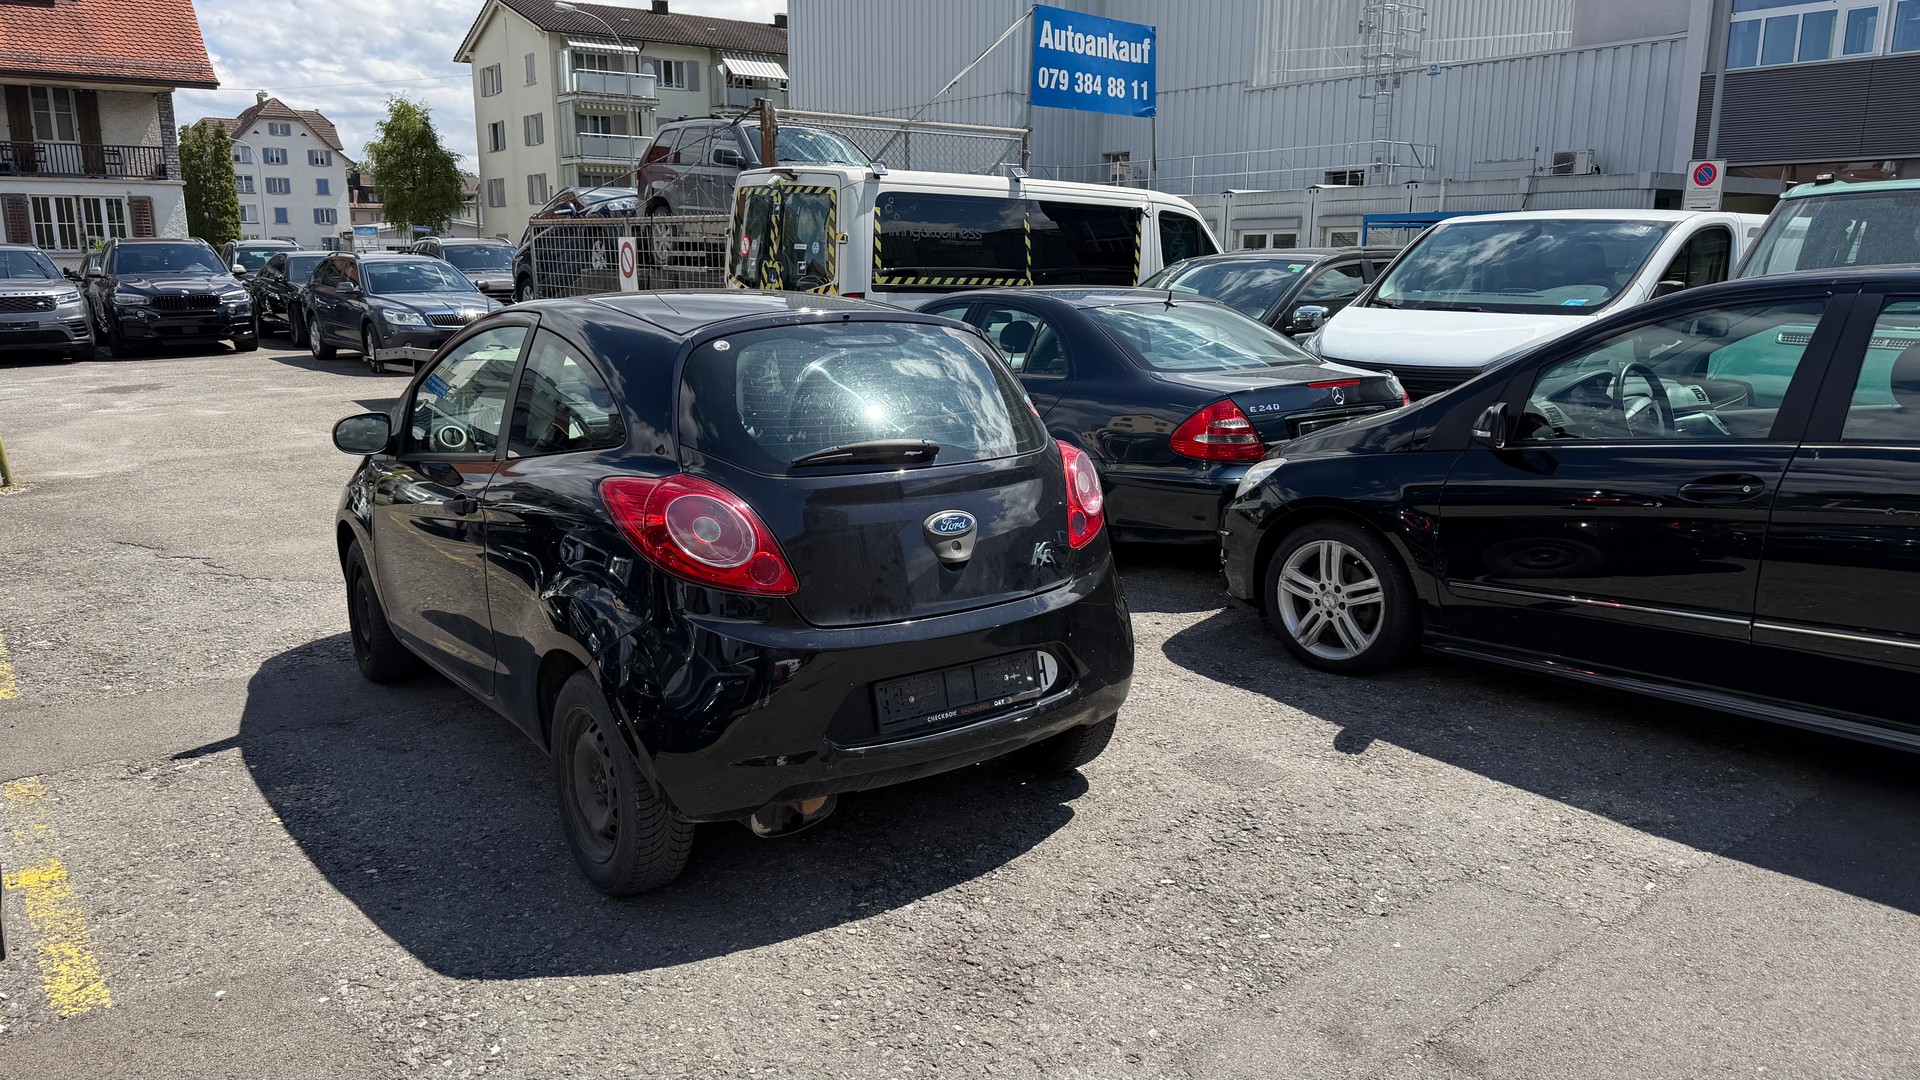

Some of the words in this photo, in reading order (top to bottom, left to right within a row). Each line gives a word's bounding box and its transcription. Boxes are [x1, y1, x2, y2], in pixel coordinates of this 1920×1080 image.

[1039, 20, 1150, 64] Autoankauf
[1038, 66, 1069, 91] 079
[1074, 71, 1102, 96] 384
[1107, 76, 1126, 99] 88
[1131, 79, 1148, 101] 11
[1259, 403, 1280, 412] 240
[940, 516, 967, 531] Ford
[927, 710, 957, 723] CHECKBOX
